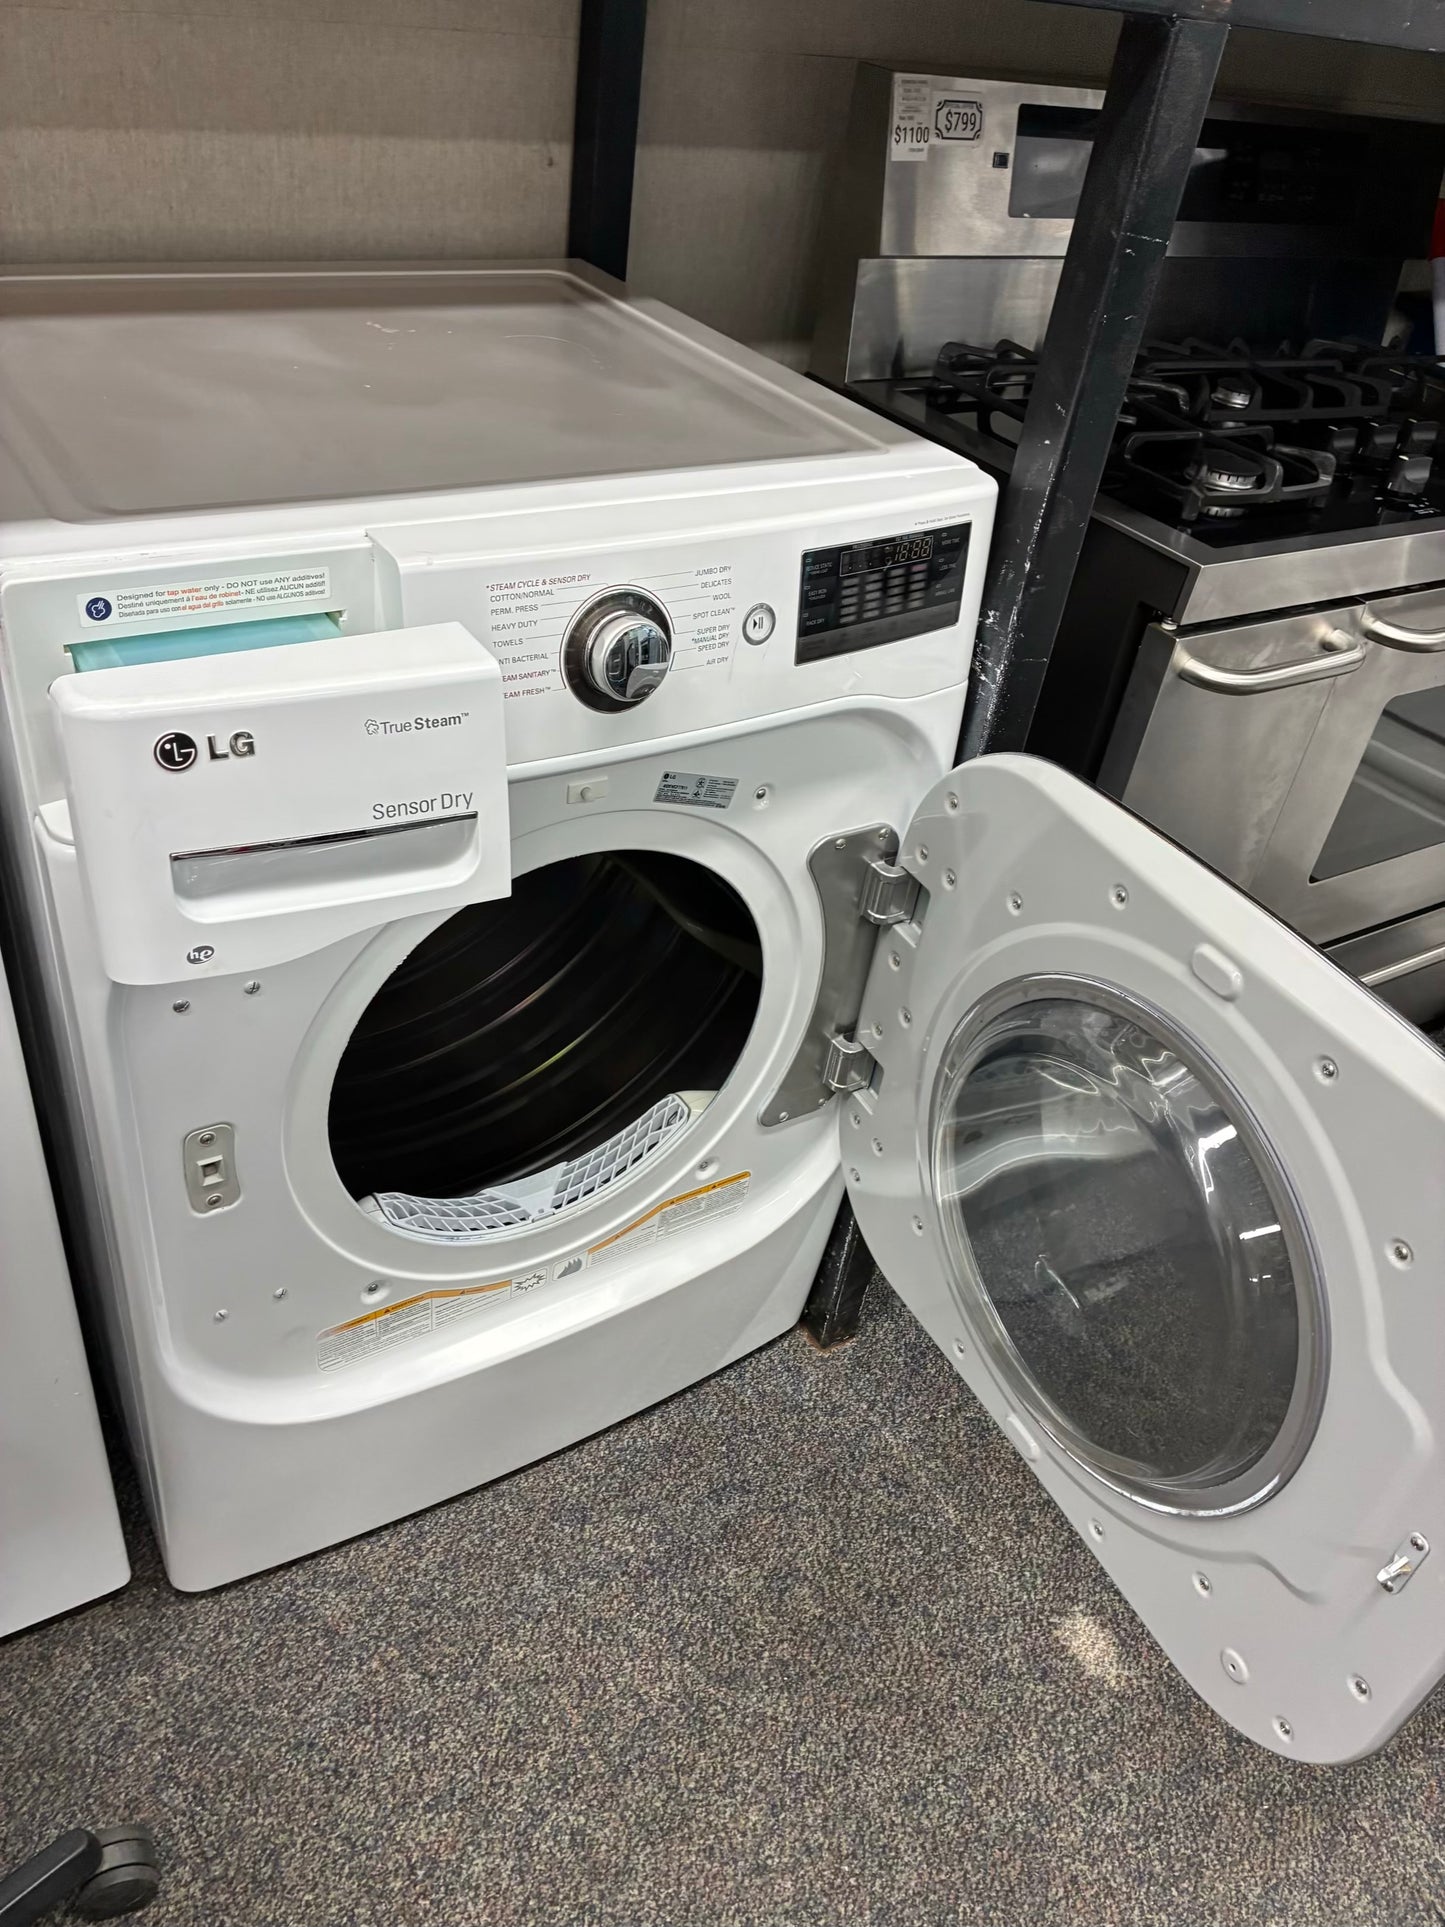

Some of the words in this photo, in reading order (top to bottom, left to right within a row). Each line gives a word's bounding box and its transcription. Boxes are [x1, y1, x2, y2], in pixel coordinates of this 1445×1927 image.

[945, 109, 977, 133] $799
[894, 124, 930, 145] $1100
[695, 567, 718, 576] JUMBO
[719, 565, 732, 574] DRY
[116, 593, 154, 602] Designed
[180, 587, 203, 595] water
[226, 581, 239, 589] DO
[240, 579, 258, 588] NOT
[274, 575, 291, 584] ANY
[291, 572, 326, 582] additives!
[517, 579, 540, 589] CYCLE
[541, 578, 547, 586] &
[548, 575, 577, 586] SENSOR
[577, 573, 592, 582] DRY
[700, 578, 733, 589] DELICATES
[145, 597, 185, 606] uniquement
[279, 582, 304, 591] AUCUN
[276, 590, 304, 600] ALGUNOS
[490, 588, 555, 603] COTTON/NORMAL
[712, 592, 732, 601] WOOL
[490, 608, 514, 617] PERM.
[515, 604, 539, 613] PRESS
[692, 611, 709, 620] SPOT
[491, 622, 517, 632] HEAVY
[517, 620, 538, 629] DUTY
[696, 626, 717, 636] SUPER
[717, 624, 731, 632] DRY
[718, 632, 730, 640] DRY
[493, 638, 524, 649] TOWELS
[697, 643, 717, 653] SPEED
[717, 641, 730, 649] DRY
[499, 657, 511, 666] NTI
[511, 653, 549, 664] BACTERIAL
[716, 655, 729, 664] DRY
[502, 674, 518, 683] EAM
[504, 690, 521, 700] EAM
[380, 721, 412, 735] True
[207, 731, 256, 760] LG
[372, 799, 437, 820] Sensor
[441, 792, 473, 810] Dry
